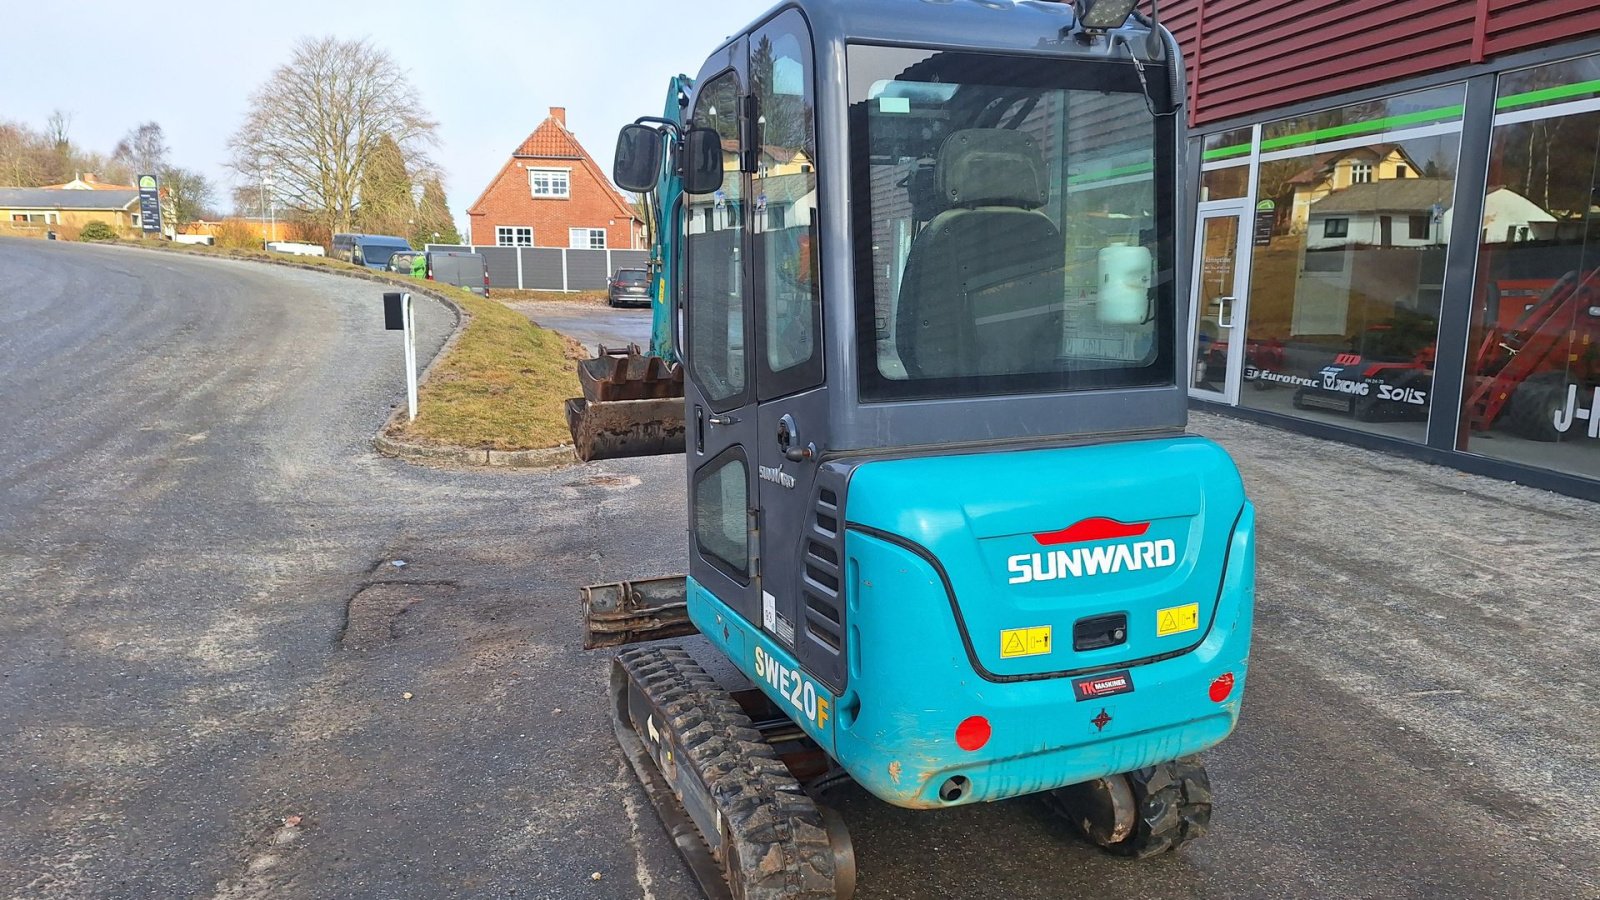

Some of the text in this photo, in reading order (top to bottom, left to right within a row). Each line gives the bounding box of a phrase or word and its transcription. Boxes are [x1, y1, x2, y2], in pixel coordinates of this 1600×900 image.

[1260, 370, 1320, 388] Eurotrac
[1335, 379, 1370, 396] XCMG
[1377, 384, 1427, 405] Solis
[1007, 538, 1176, 585] SUNWARD
[755, 646, 829, 729] SWE20F
[1079, 681, 1097, 696] TK
[1094, 678, 1127, 690] MASKINER
